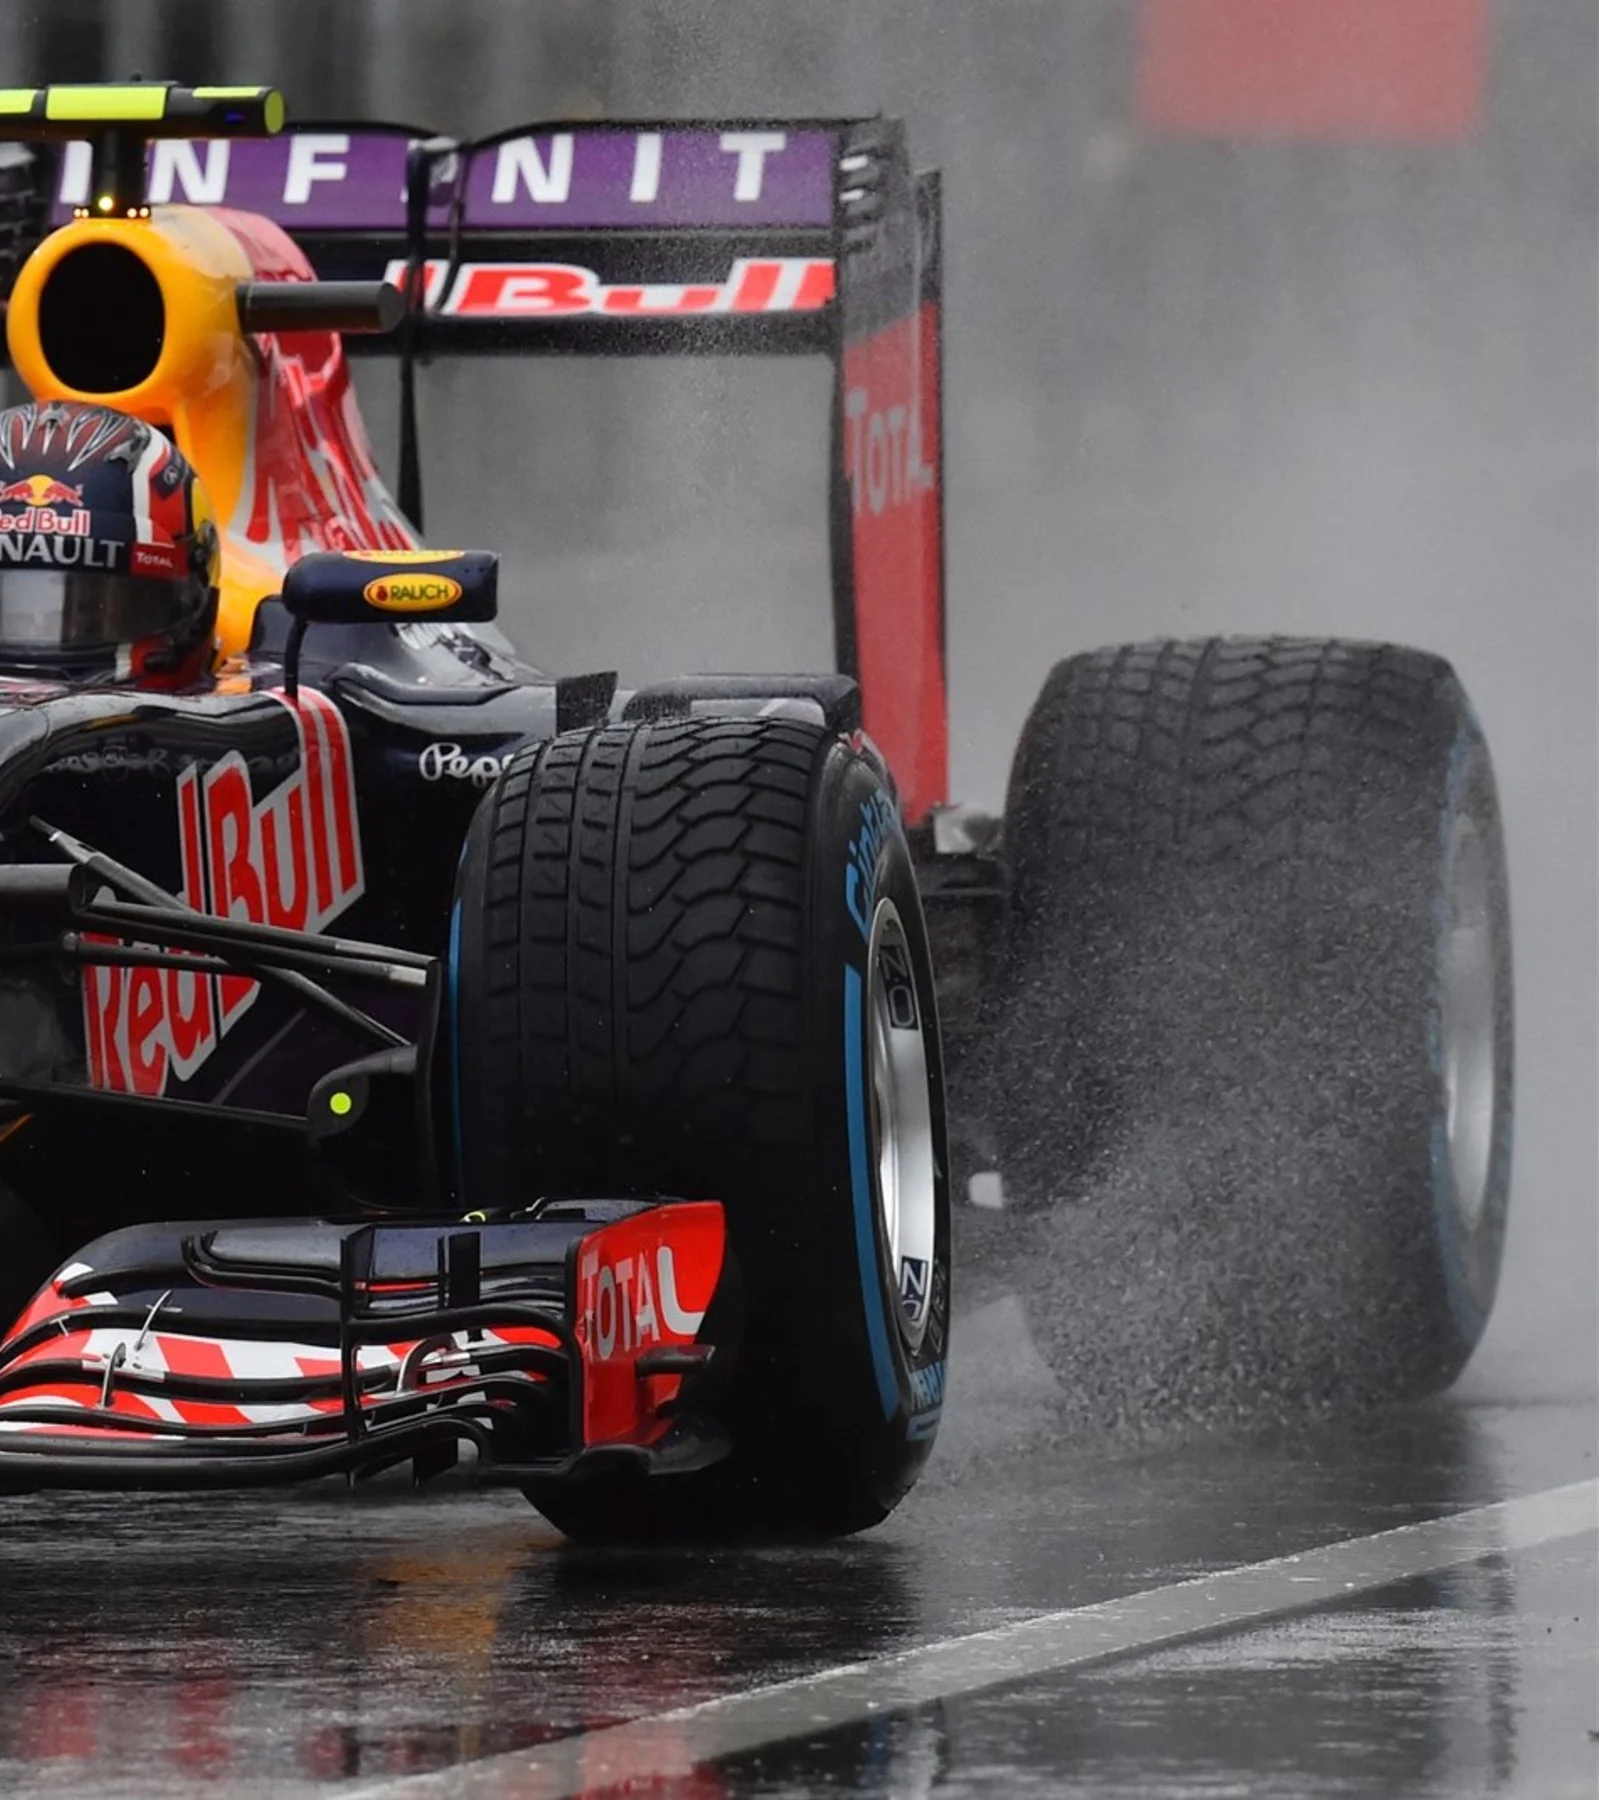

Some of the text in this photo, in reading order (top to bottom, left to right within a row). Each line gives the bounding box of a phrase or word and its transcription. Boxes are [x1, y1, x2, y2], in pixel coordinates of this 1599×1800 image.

[59, 134, 868, 204] INFNIT
[37, 509, 91, 536] Bull
[136, 552, 174, 569] TOTAL
[390, 585, 449, 601] RAUCH
[582, 1246, 705, 1363] TOTAL
